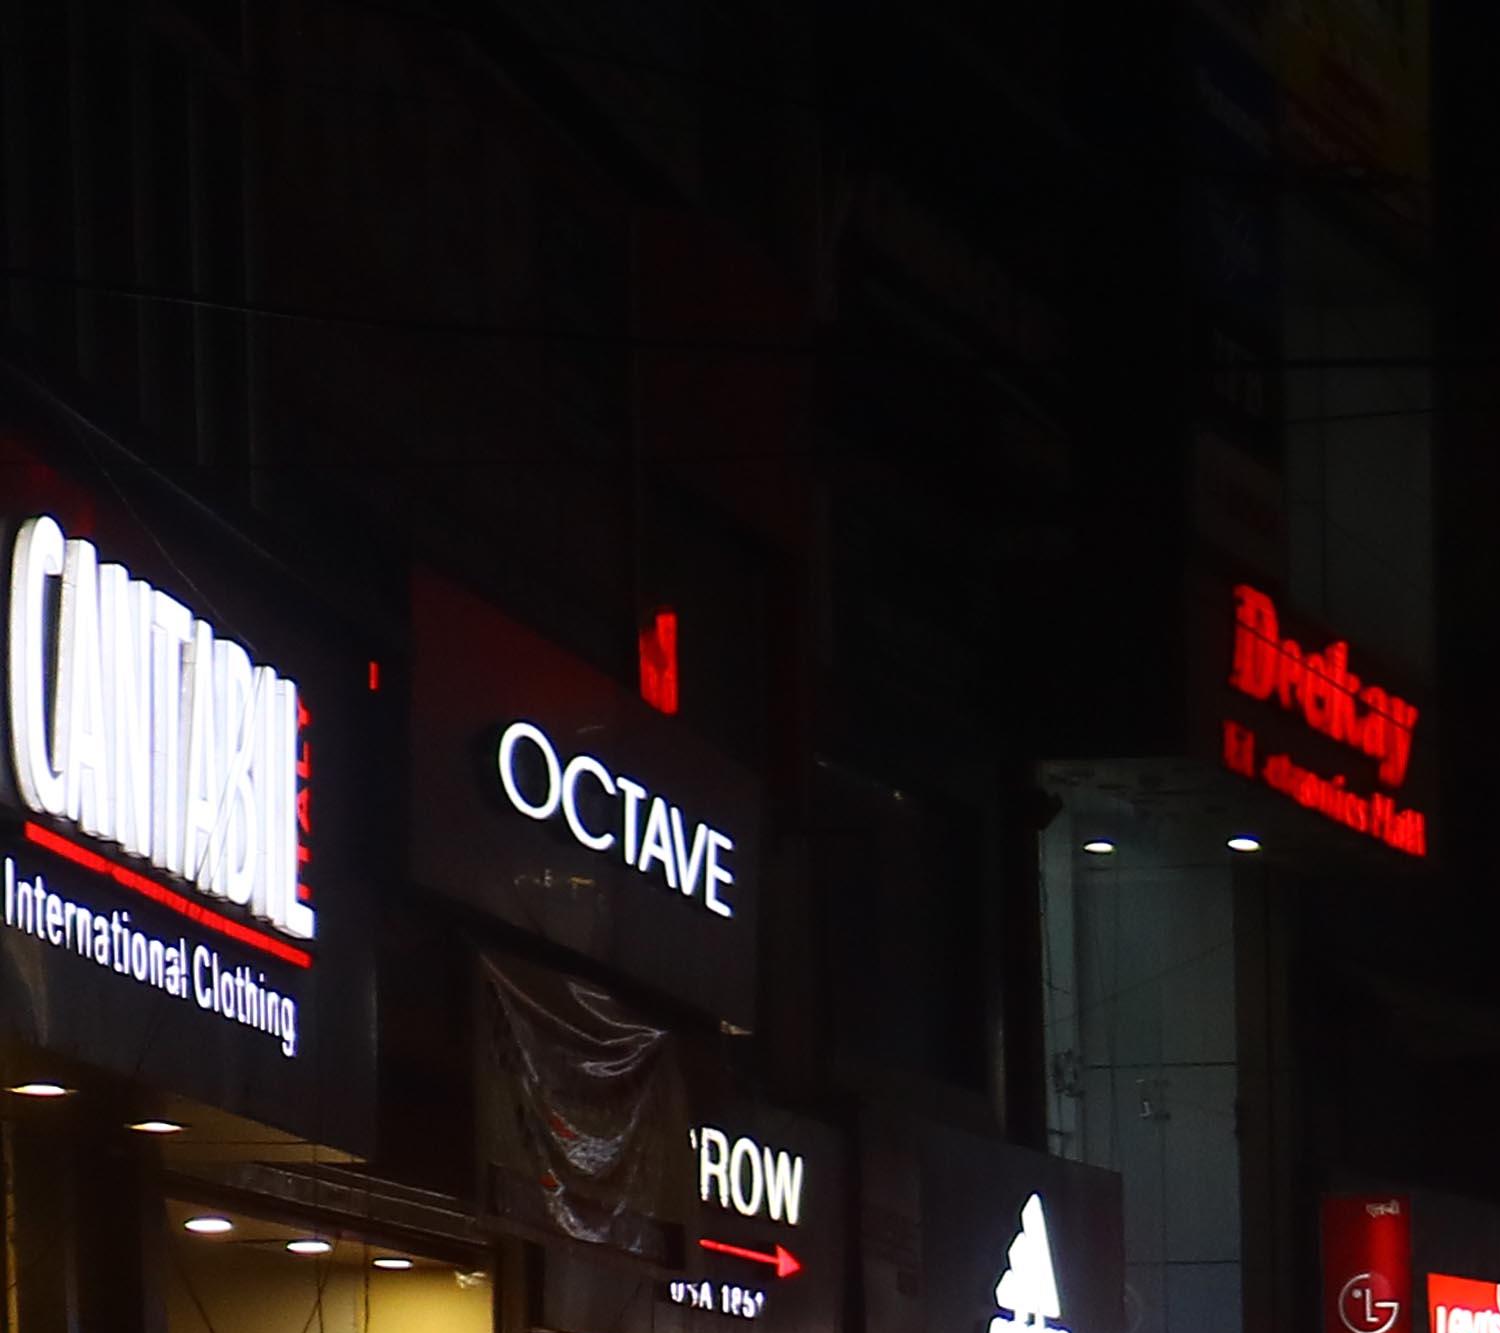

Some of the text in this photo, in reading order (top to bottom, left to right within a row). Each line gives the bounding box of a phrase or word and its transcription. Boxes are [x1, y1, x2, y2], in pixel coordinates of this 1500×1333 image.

[10, 515, 314, 939] CANTABIL
[498, 721, 734, 919] OCTAVE
[4, 858, 298, 1058] International Clothing
[690, 1127, 803, 1226] ROW
